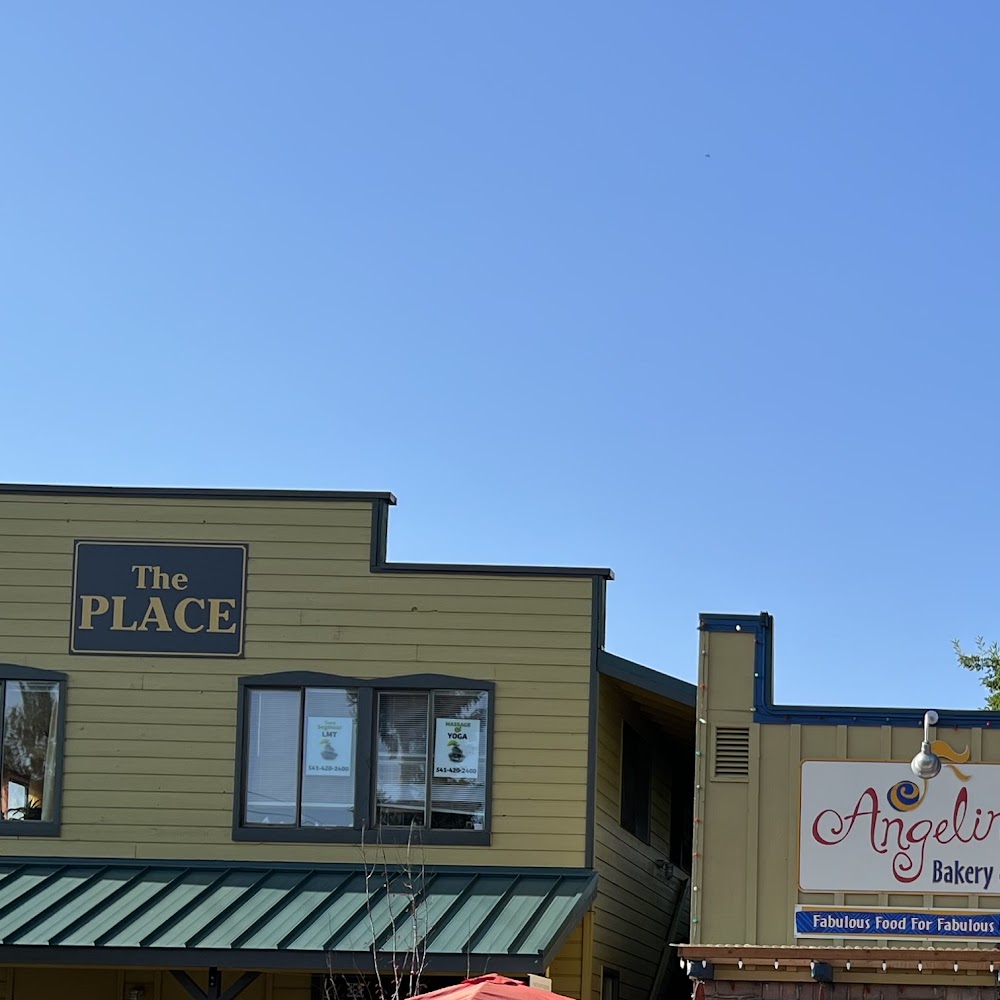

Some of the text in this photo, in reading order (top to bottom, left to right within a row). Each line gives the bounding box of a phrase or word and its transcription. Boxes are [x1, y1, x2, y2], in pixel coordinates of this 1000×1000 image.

[131, 565, 189, 590] The
[78, 594, 237, 634] PLACE
[308, 764, 350, 772] 541-420-2400
[932, 859, 994, 889] Bakery
[813, 914, 871, 930] Fabulous
[875, 916, 907, 931] Food
[911, 917, 933, 931] For
[937, 917, 995, 933] Fabulous
